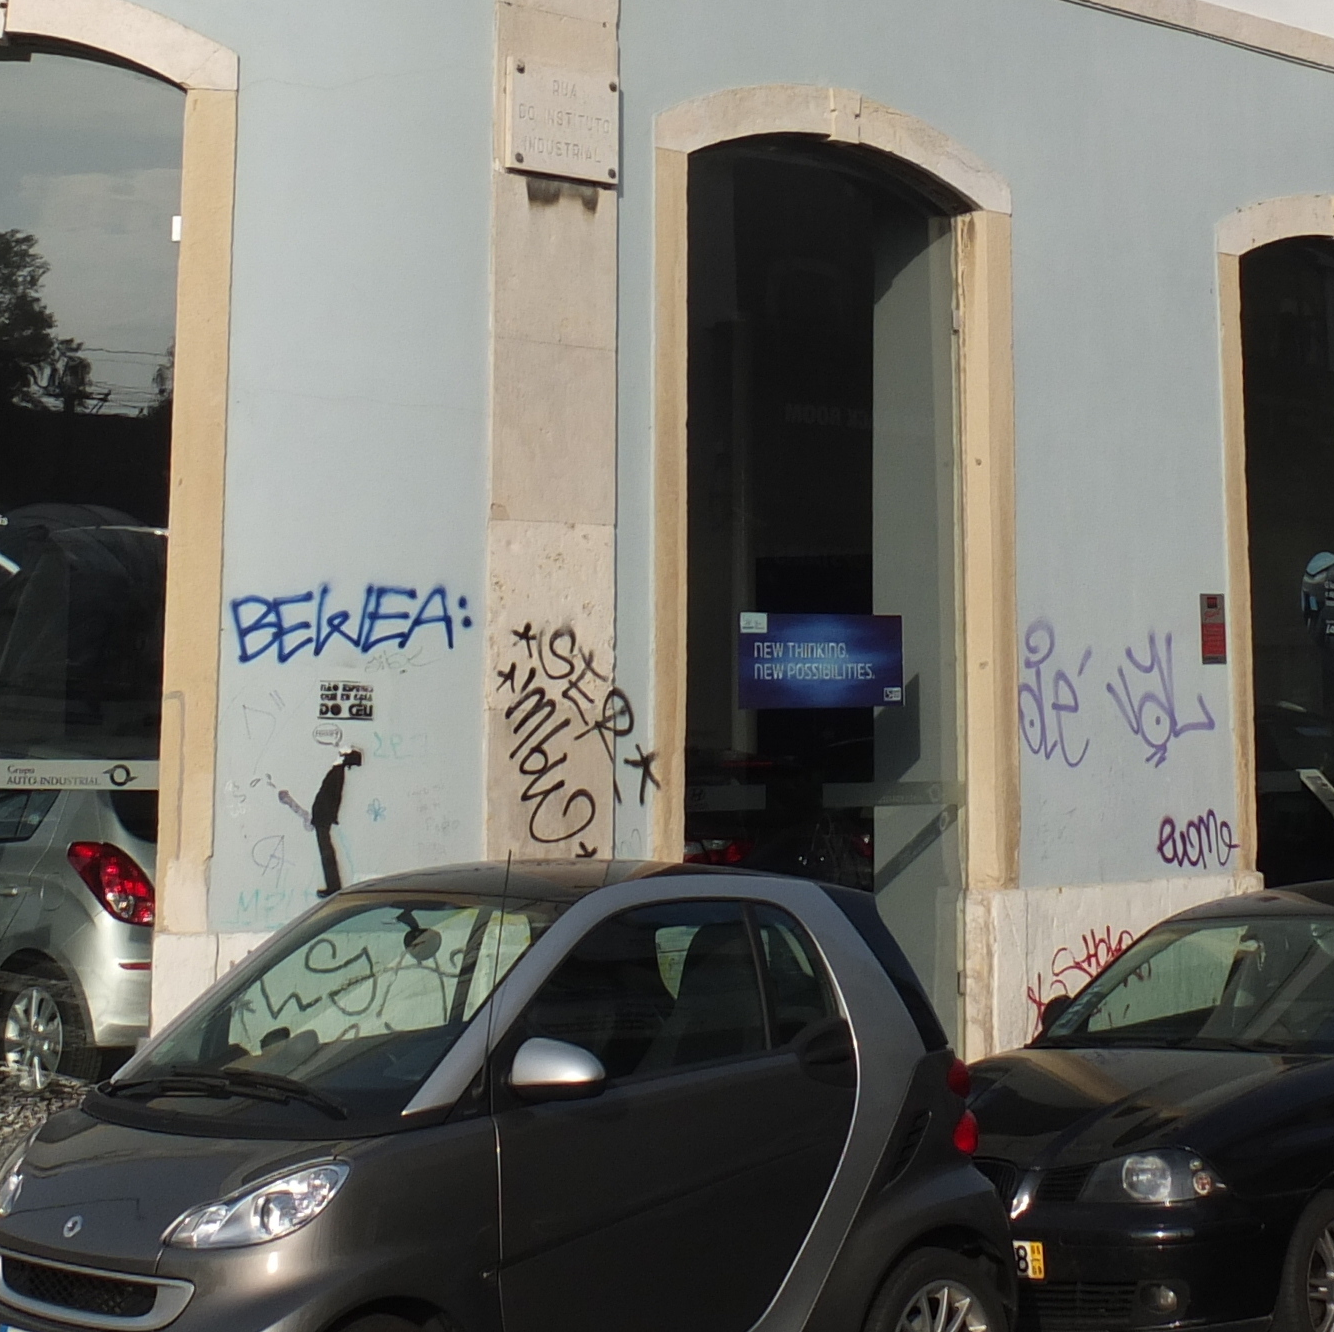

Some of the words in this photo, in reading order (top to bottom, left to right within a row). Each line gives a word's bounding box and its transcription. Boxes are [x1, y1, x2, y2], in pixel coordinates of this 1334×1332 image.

[552, 79, 578, 98] RUA
[519, 103, 536, 121] DO
[544, 108, 611, 134] INSTITUTO
[524, 136, 602, 163] INDUSTRIAL
[754, 642, 784, 658] NEW
[787, 642, 849, 659] THINKING.
[754, 664, 784, 680] NEW
[787, 663, 876, 680] POSSIBILITIES.
[7, 776, 37, 785] AUTO
[39, 776, 102, 786] INDUSTRIAL
